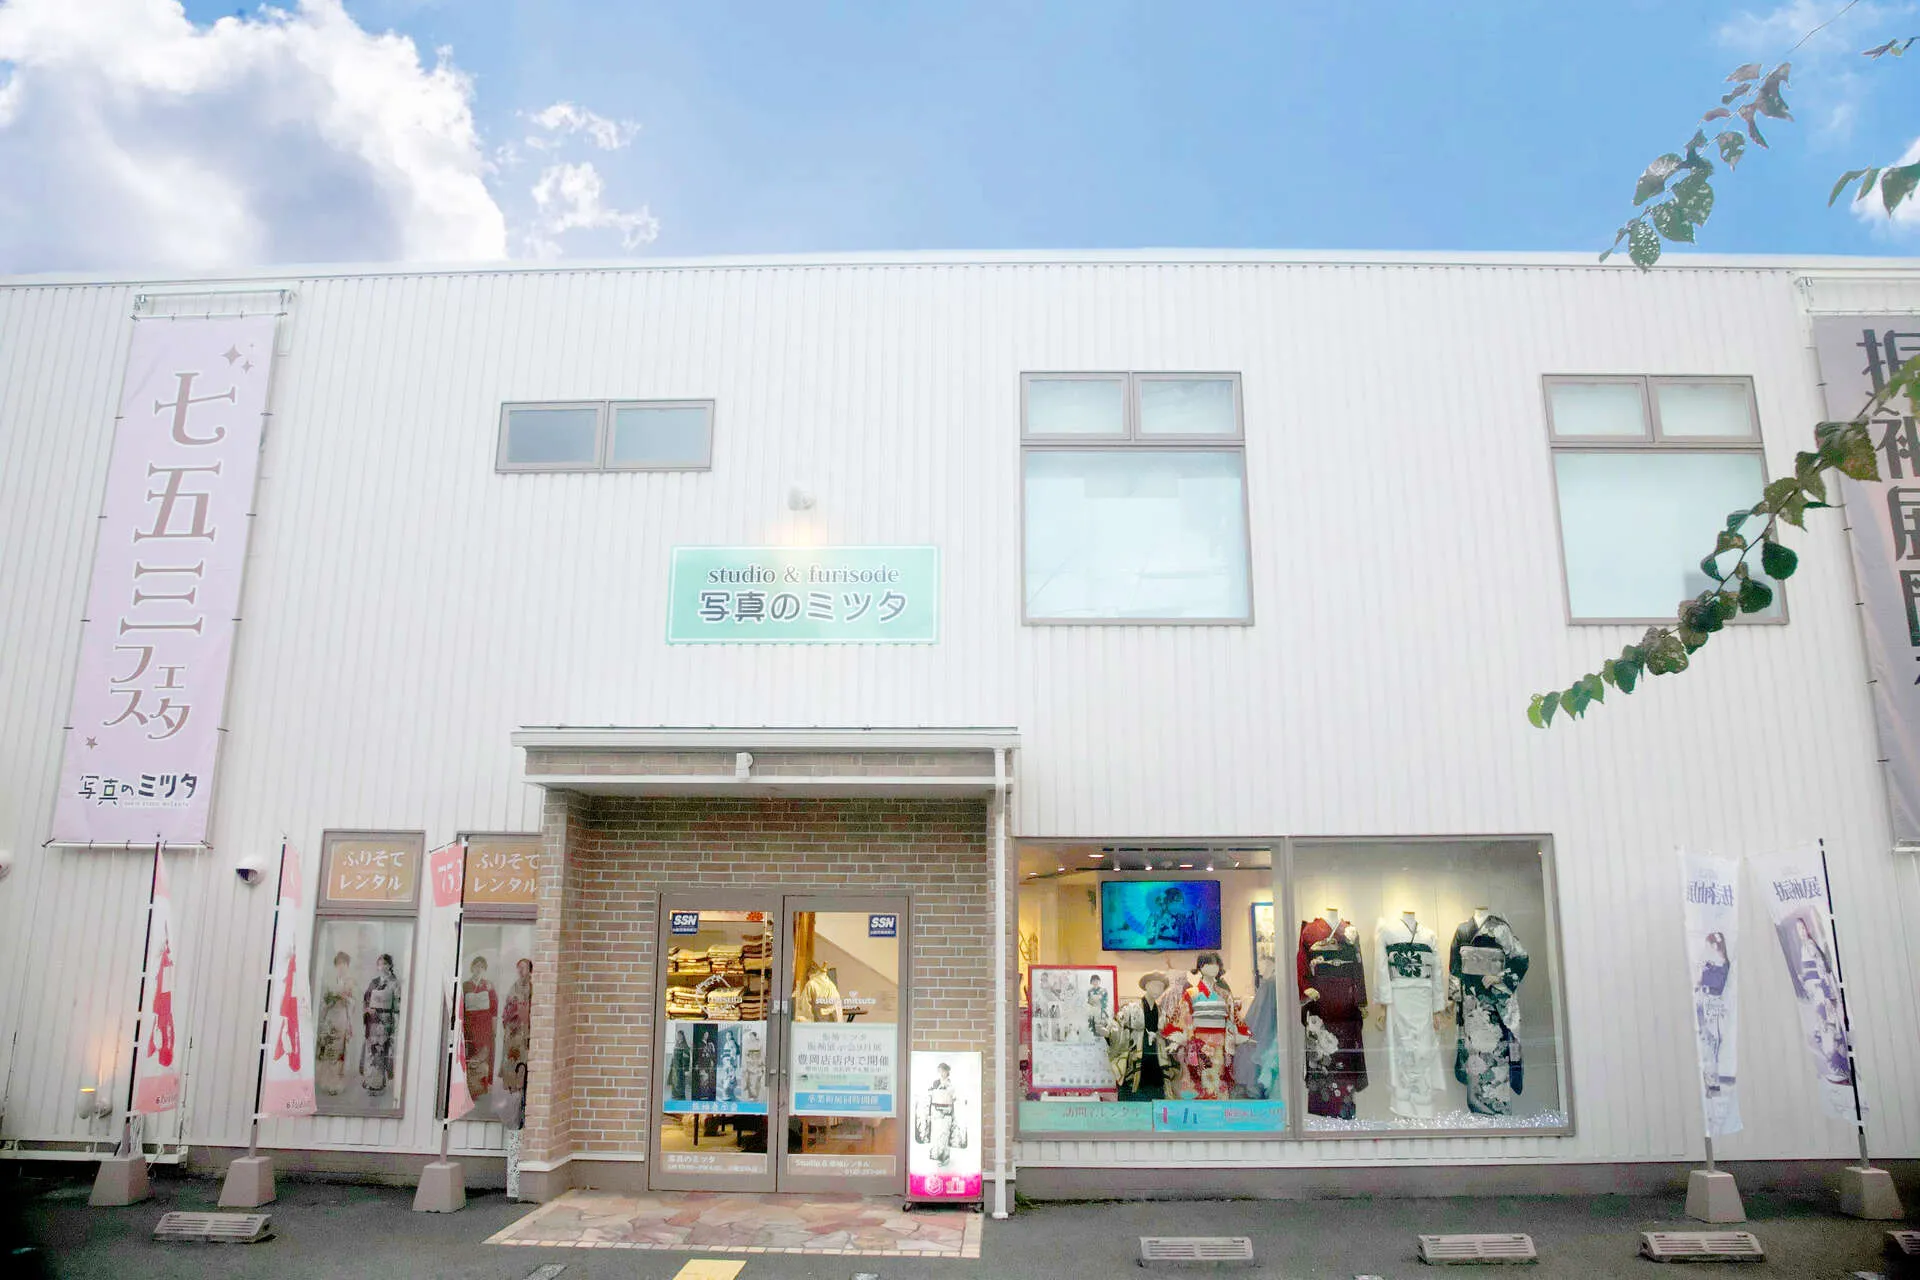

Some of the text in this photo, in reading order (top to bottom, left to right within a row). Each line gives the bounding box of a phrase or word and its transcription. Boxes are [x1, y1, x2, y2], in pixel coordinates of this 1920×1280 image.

[708, 564, 900, 584] studio & furisode
[699, 589, 907, 623] 写真のミツタ
[78, 772, 198, 806] 写真のミツタ
[339, 873, 404, 891] レンタル
[473, 876, 537, 894] レンタル
[673, 914, 697, 926] SSN
[871, 917, 895, 928] SSN
